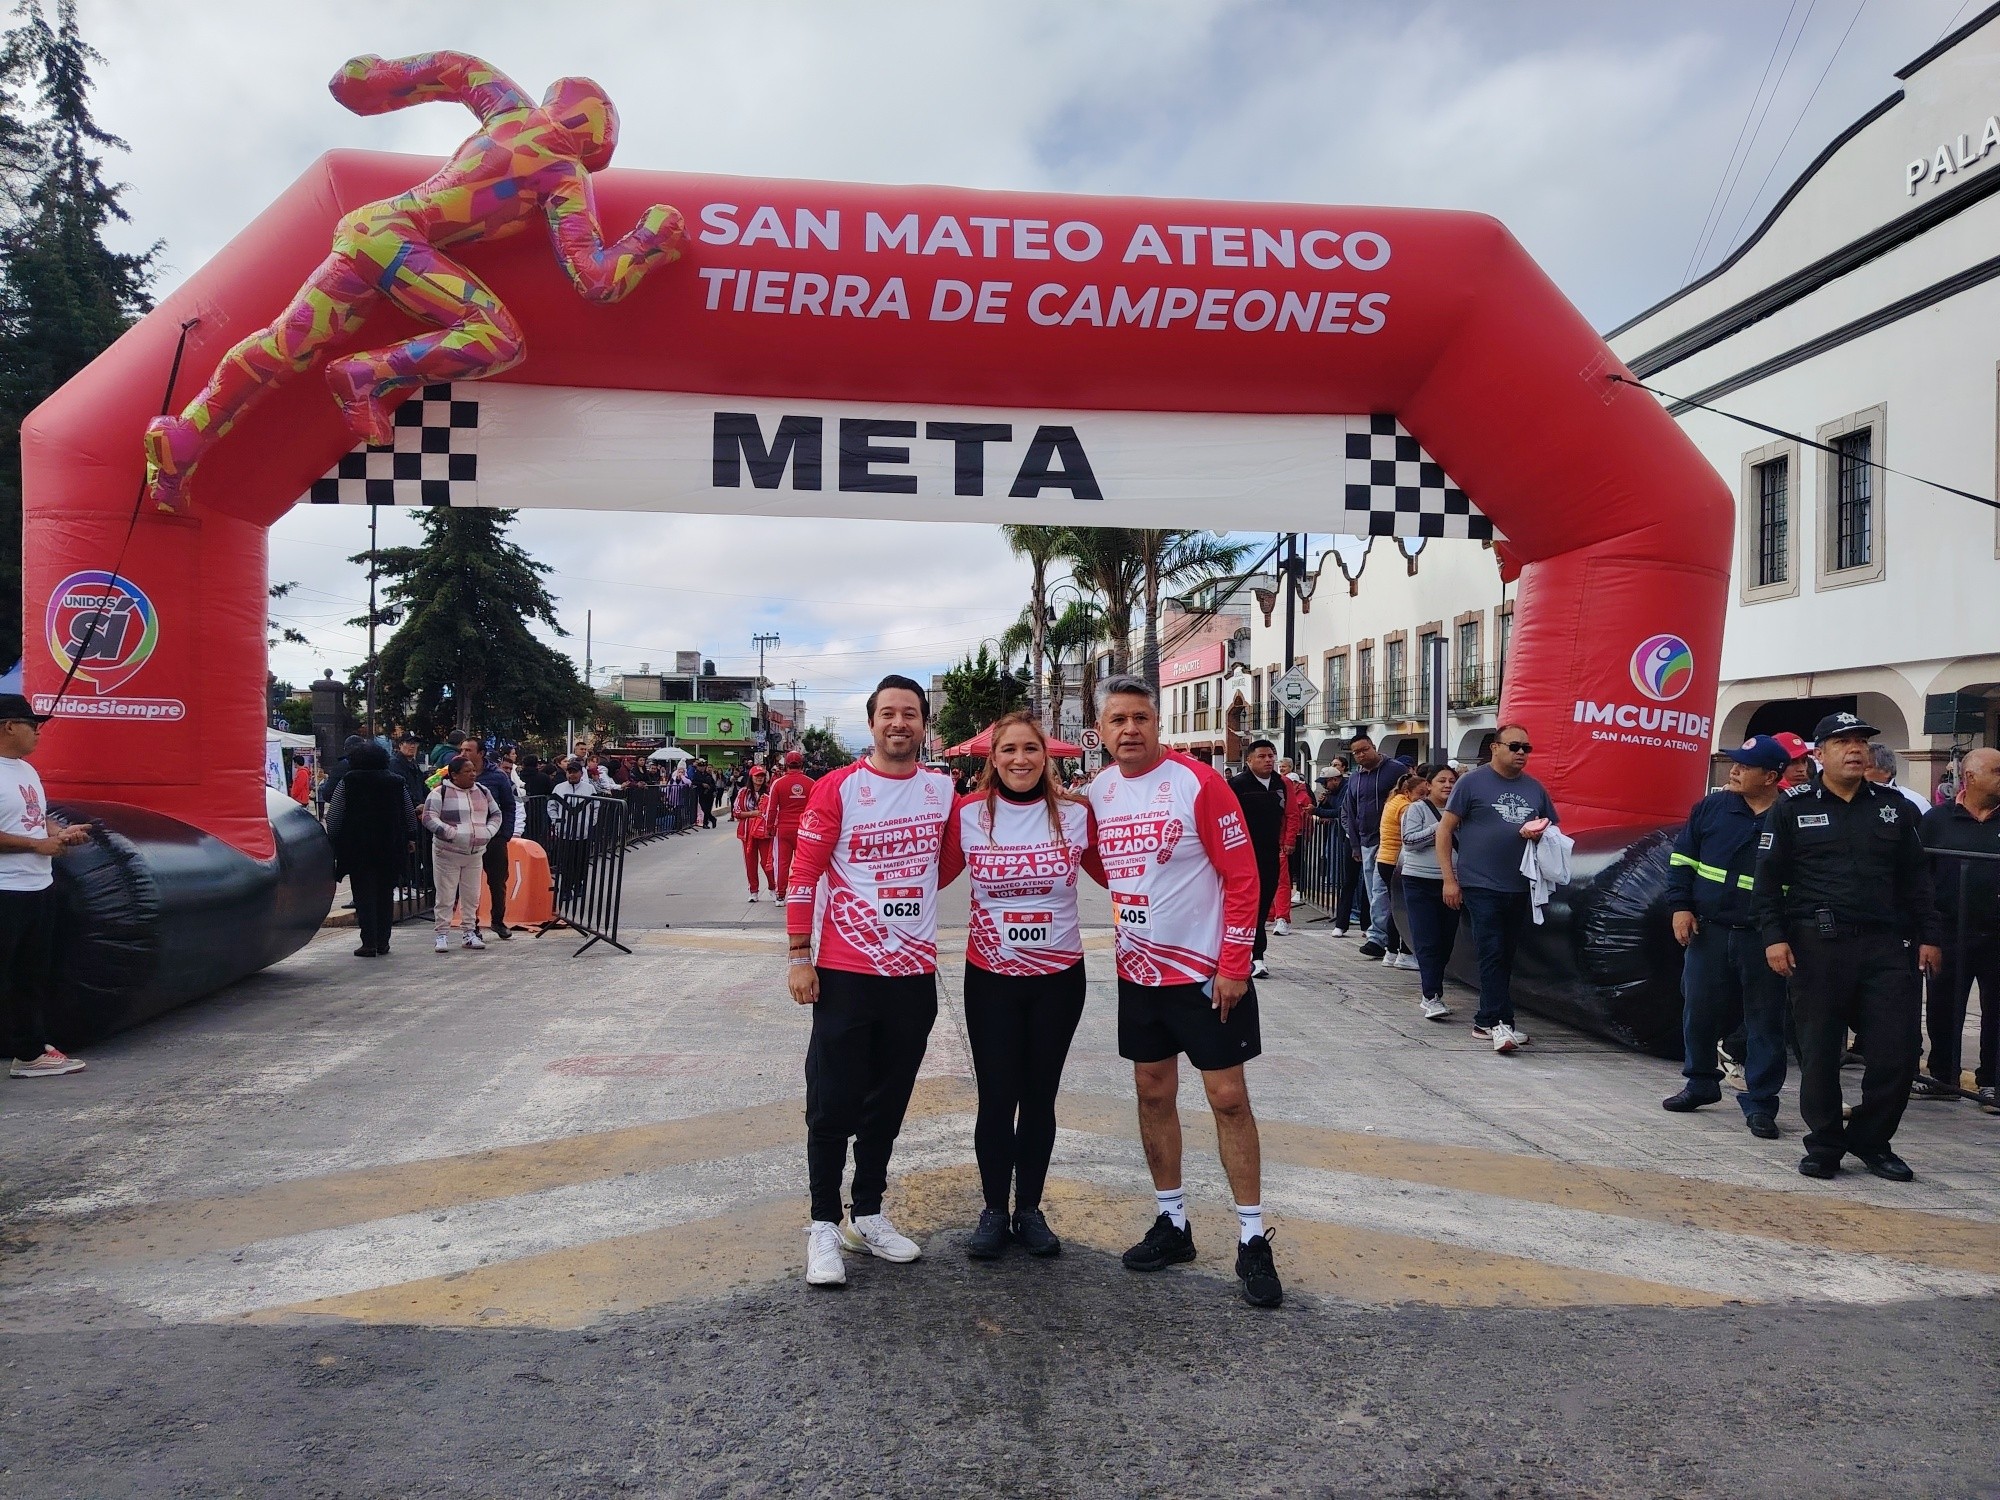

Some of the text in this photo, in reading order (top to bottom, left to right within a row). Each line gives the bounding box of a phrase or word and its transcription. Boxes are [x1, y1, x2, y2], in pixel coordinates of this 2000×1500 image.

[1906, 116, 2000, 197] PALA
[698, 203, 1392, 271] SAN MATEO ATENCO
[698, 267, 1392, 335] TIERRA DE CAMPEONES
[712, 412, 1104, 500] META
[64, 596, 116, 608] UNIDOS
[34, 698, 181, 718] #UnidosSiempre
[1573, 700, 1711, 739] IMCUFIDE
[1591, 730, 1698, 752] SAN MATEO ATENCO
[852, 812, 943, 832] GRAN CARRERA ATLÉTICA
[1134, 809, 1170, 820] ATLÉTICA
[1217, 811, 1239, 829] 10K
[859, 824, 939, 847] TIERRA DEL
[1133, 823, 1159, 836] DEL
[1222, 823, 1244, 840] /5K
[855, 838, 939, 861] CALZADO
[992, 844, 1033, 852] CARRERA
[868, 856, 930, 871] SAN MATEO ATENCO
[975, 850, 1066, 866] TIERRA DEL
[1109, 859, 1125, 867] MATEO
[1126, 856, 1147, 865] ATENCO
[882, 871, 903, 880] 10K
[909, 866, 923, 876] 5K
[972, 862, 1068, 880] CALZADO
[1109, 869, 1123, 879] 10K
[1127, 866, 1140, 877] 5K
[796, 886, 813, 895] 5K
[995, 889, 1017, 898] 10K
[883, 902, 920, 917] 0628
[1008, 927, 1047, 941] 0001
[1226, 925, 1247, 936] 10K
